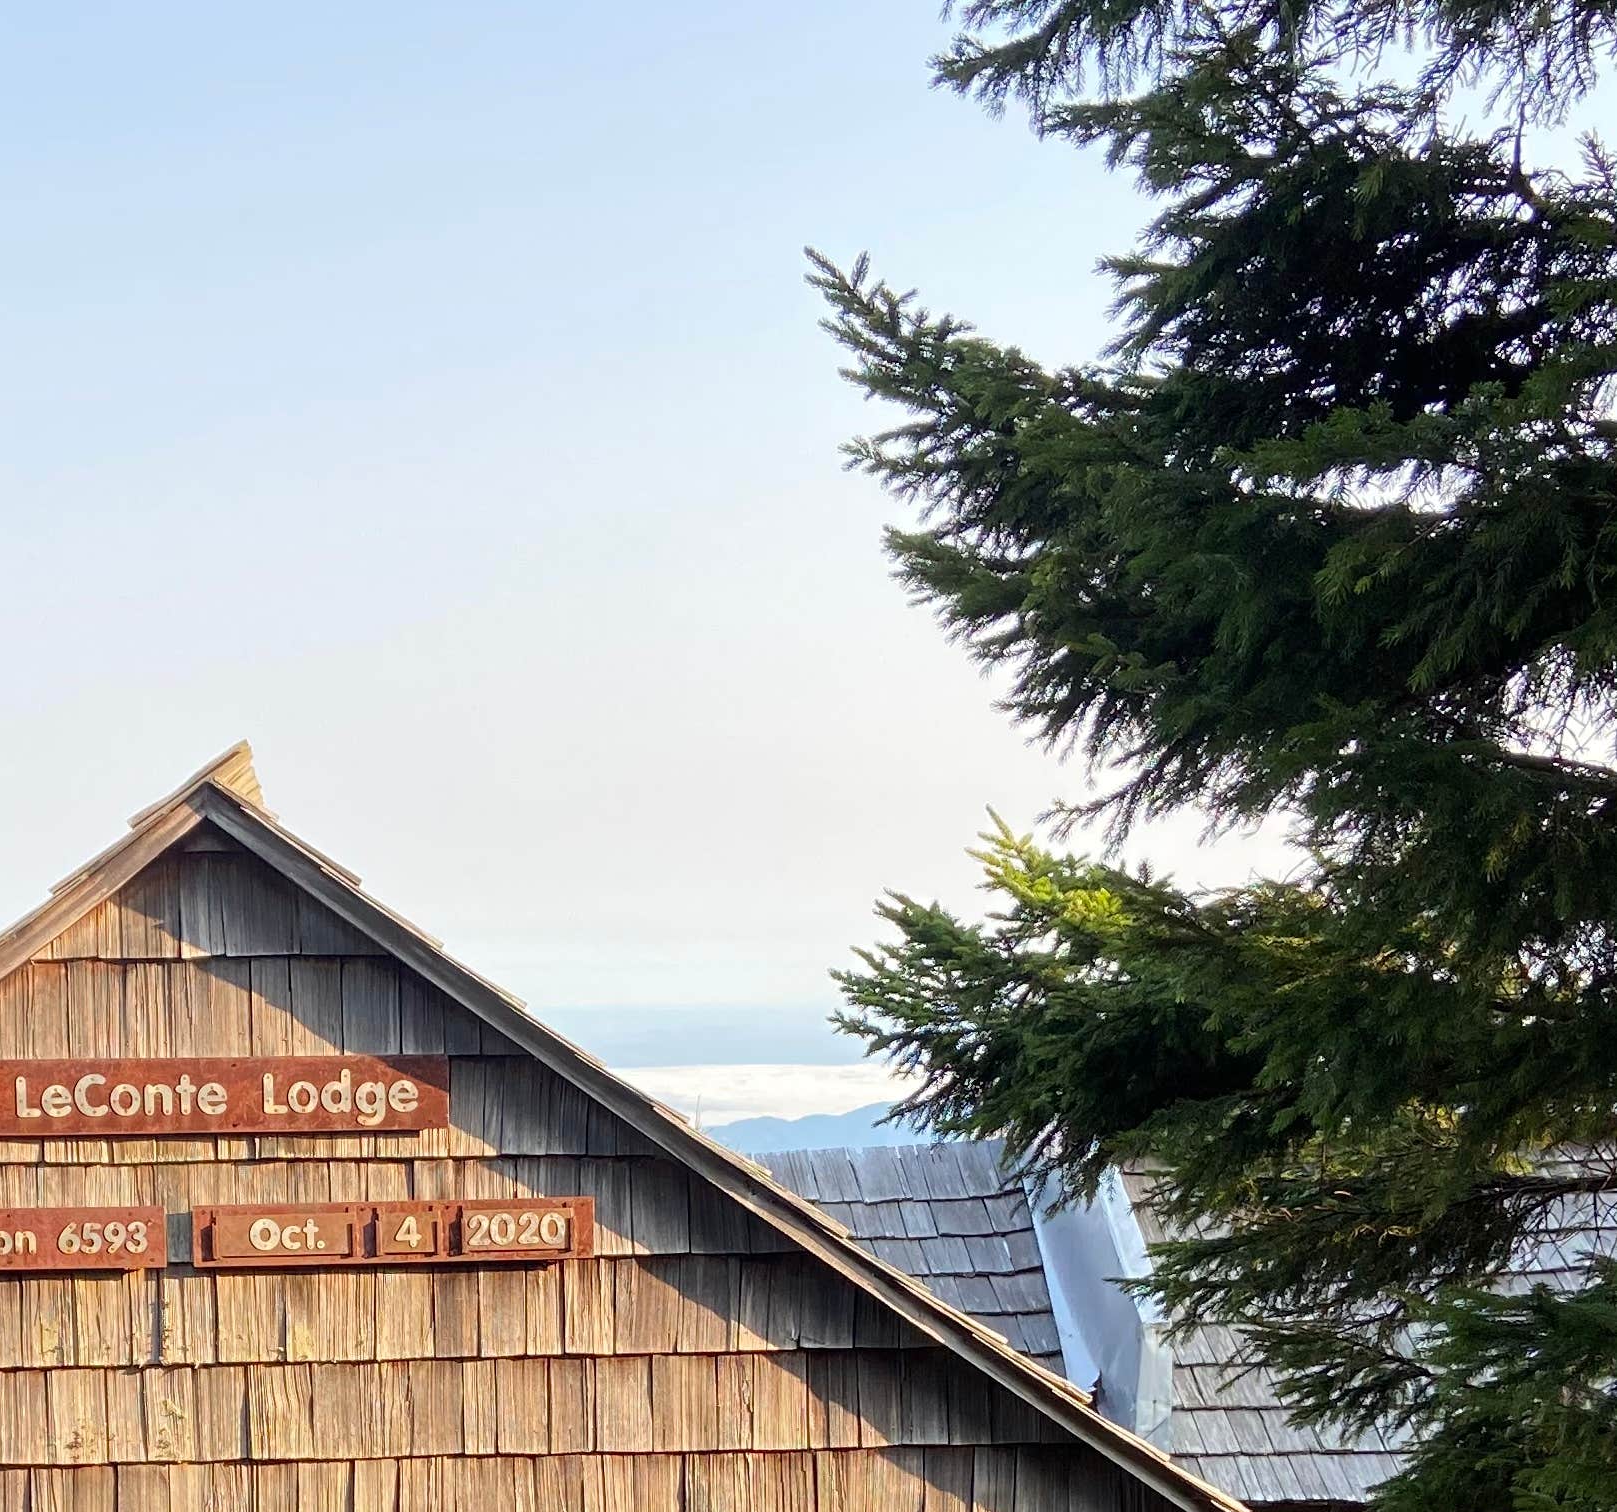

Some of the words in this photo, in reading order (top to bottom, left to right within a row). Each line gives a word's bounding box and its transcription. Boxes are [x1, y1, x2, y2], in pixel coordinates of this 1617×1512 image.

[15, 1073, 228, 1119] LeConte
[262, 1068, 420, 1127] Lodge
[57, 1221, 149, 1255] 6593
[248, 1217, 326, 1251] Oct.
[394, 1215, 423, 1248] 4
[467, 1211, 568, 1247] 2020
